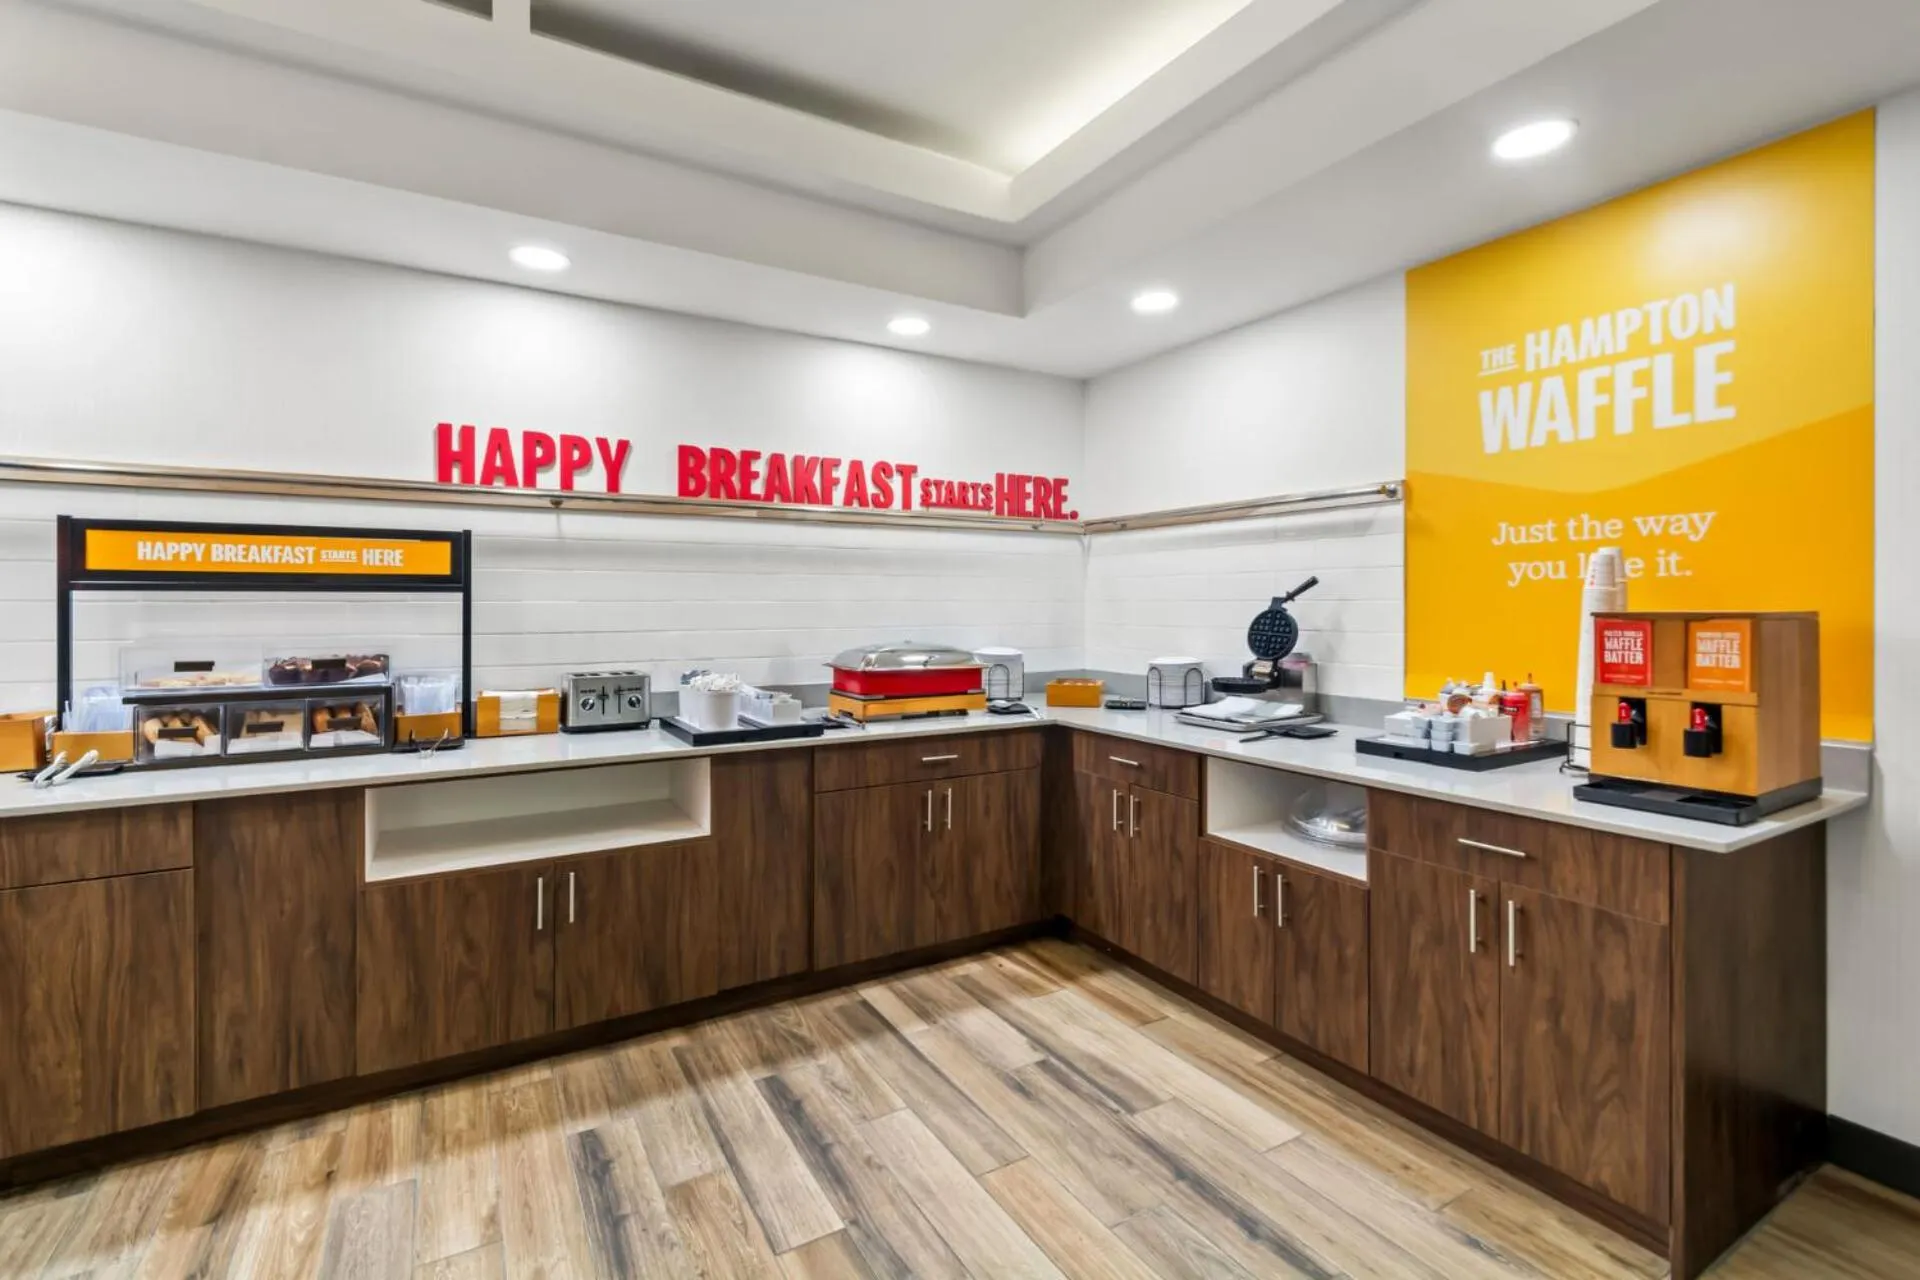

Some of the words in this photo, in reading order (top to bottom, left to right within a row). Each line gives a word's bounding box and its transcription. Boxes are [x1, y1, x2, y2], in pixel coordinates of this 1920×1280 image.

[1478, 345, 1517, 377] THE
[1525, 283, 1736, 372] HAMPTON
[1479, 339, 1737, 455] WAFFLE
[435, 423, 632, 494] HAPPY
[678, 444, 918, 512] BREAKFAST
[919, 478, 994, 511] STARTS
[995, 472, 1079, 520] HERE.
[1491, 519, 1558, 546] Just
[1567, 513, 1624, 541] the
[1632, 511, 1717, 542] way
[137, 541, 205, 563] HAPPY
[211, 544, 316, 565] BREAKFAST
[320, 550, 357, 563] STARTS
[361, 548, 404, 567] HERE
[1507, 558, 1566, 588] you
[1578, 552, 1645, 580] le
[1655, 549, 1692, 578] it.
[1604, 637, 1643, 651] WAFFLE
[1604, 650, 1644, 665] BATTER
[1696, 639, 1740, 655] WAFFLE
